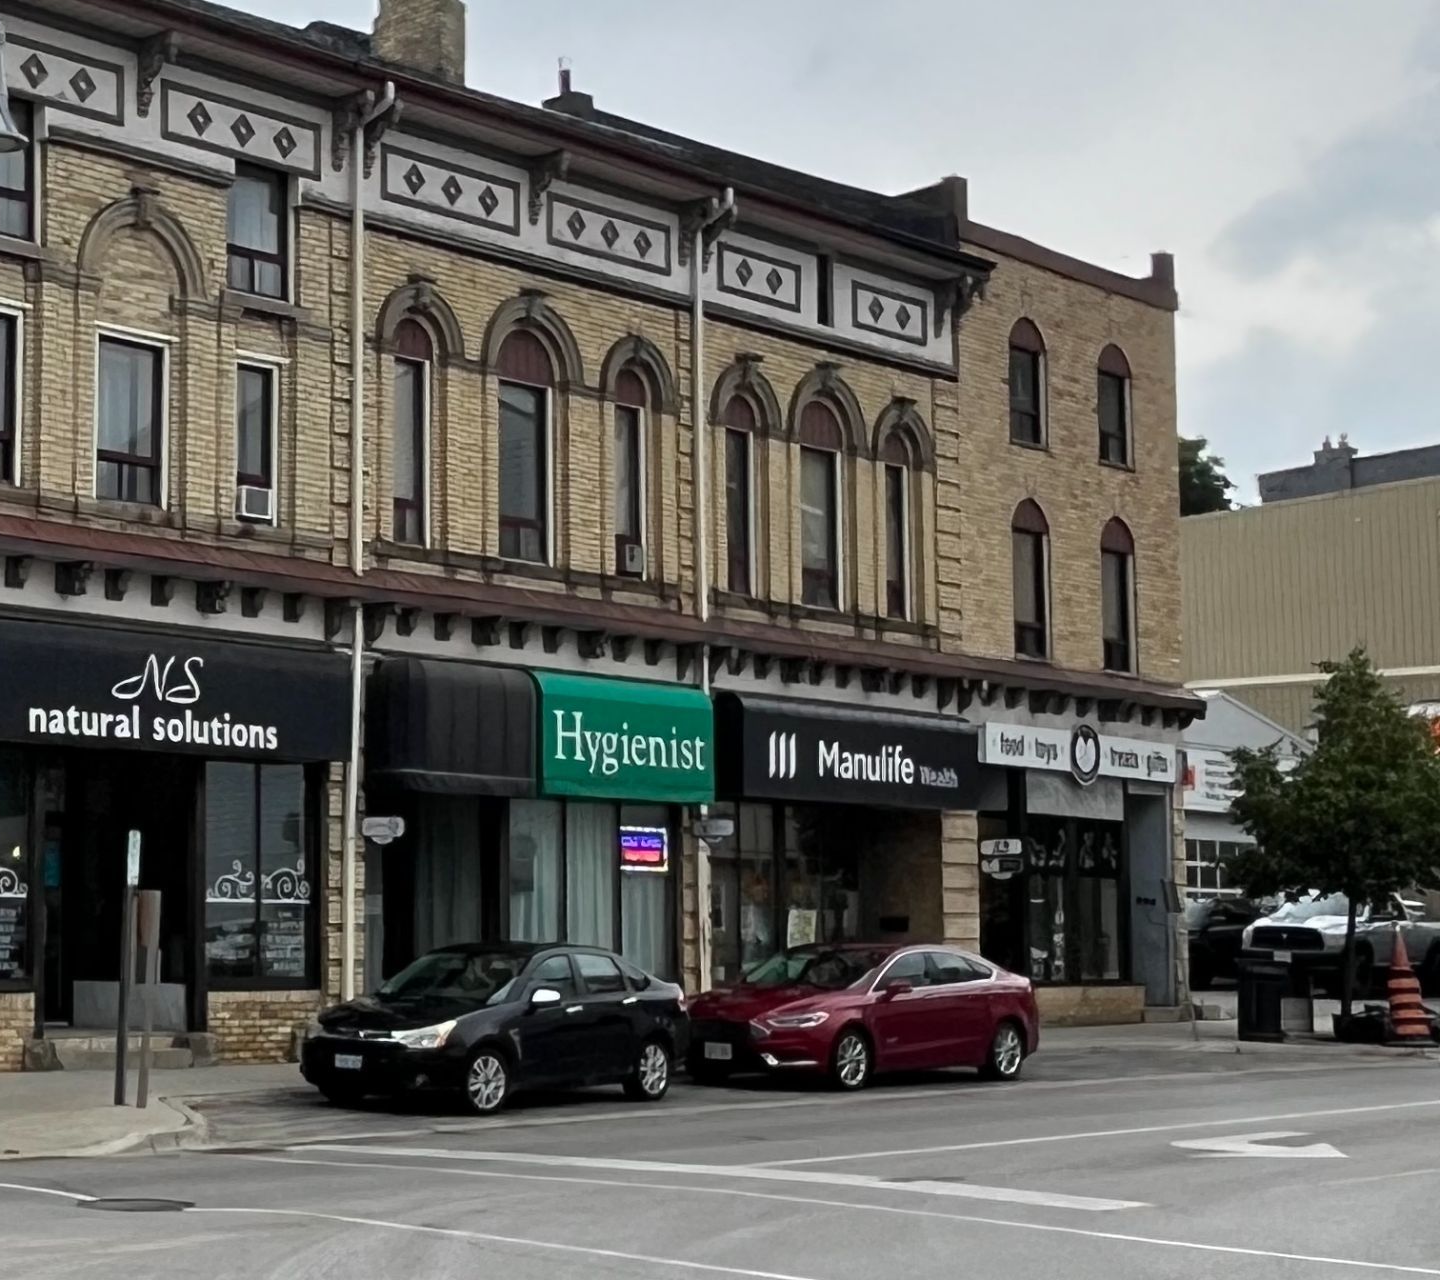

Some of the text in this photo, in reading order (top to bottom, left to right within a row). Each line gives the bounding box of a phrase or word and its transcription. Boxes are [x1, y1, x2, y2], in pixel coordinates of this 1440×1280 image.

[28, 705, 279, 750] natural solutions
[553, 709, 706, 776] Hygienist
[818, 740, 915, 785] Manulife
